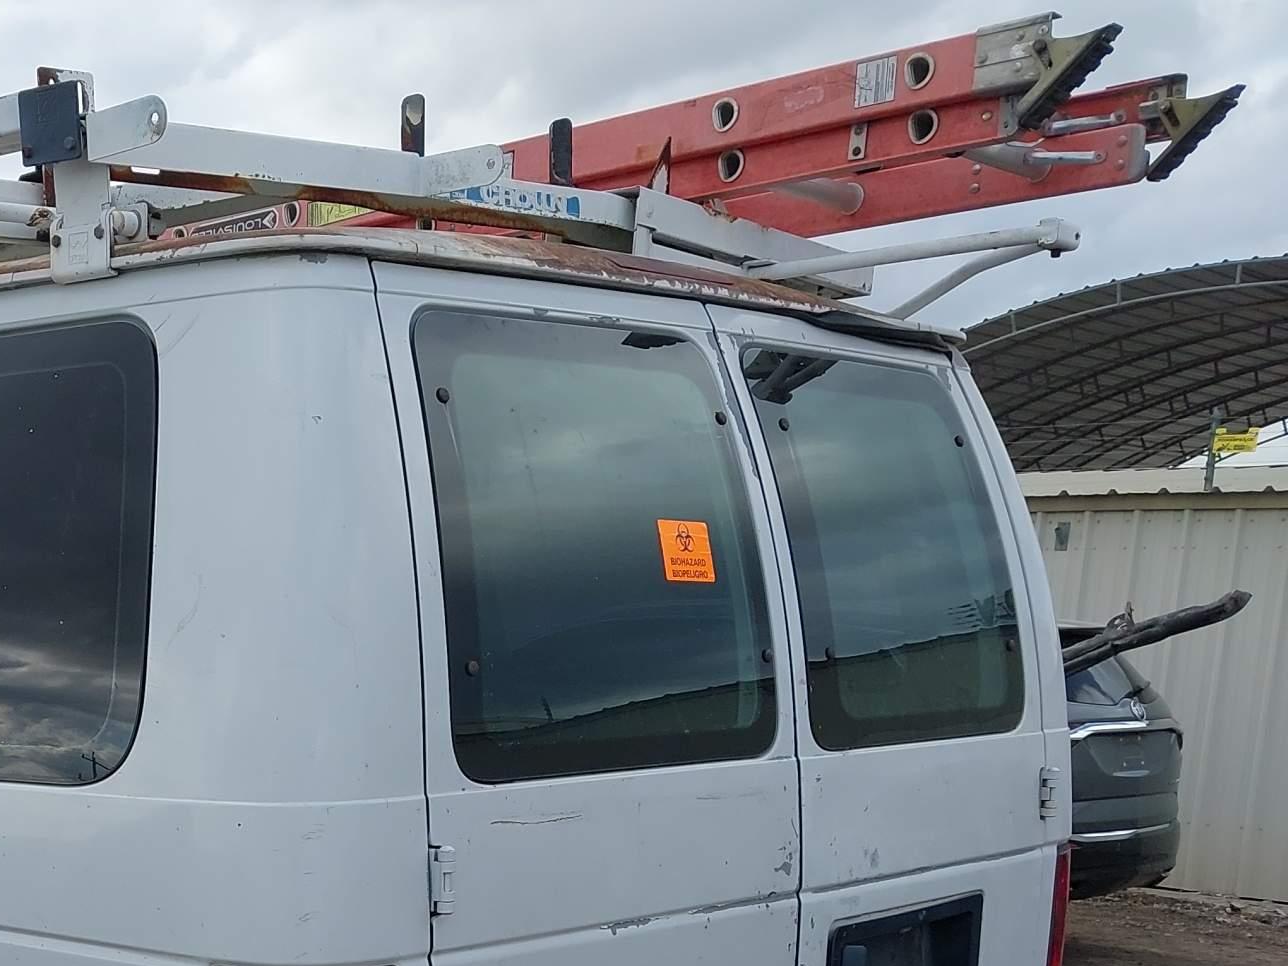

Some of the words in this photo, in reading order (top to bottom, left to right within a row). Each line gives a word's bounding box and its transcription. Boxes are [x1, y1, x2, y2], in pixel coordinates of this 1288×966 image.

[191, 218, 262, 237] LOUISVIL
[670, 557, 707, 567] BIOHAZARD
[672, 569, 709, 579] BIOPELIGRO
